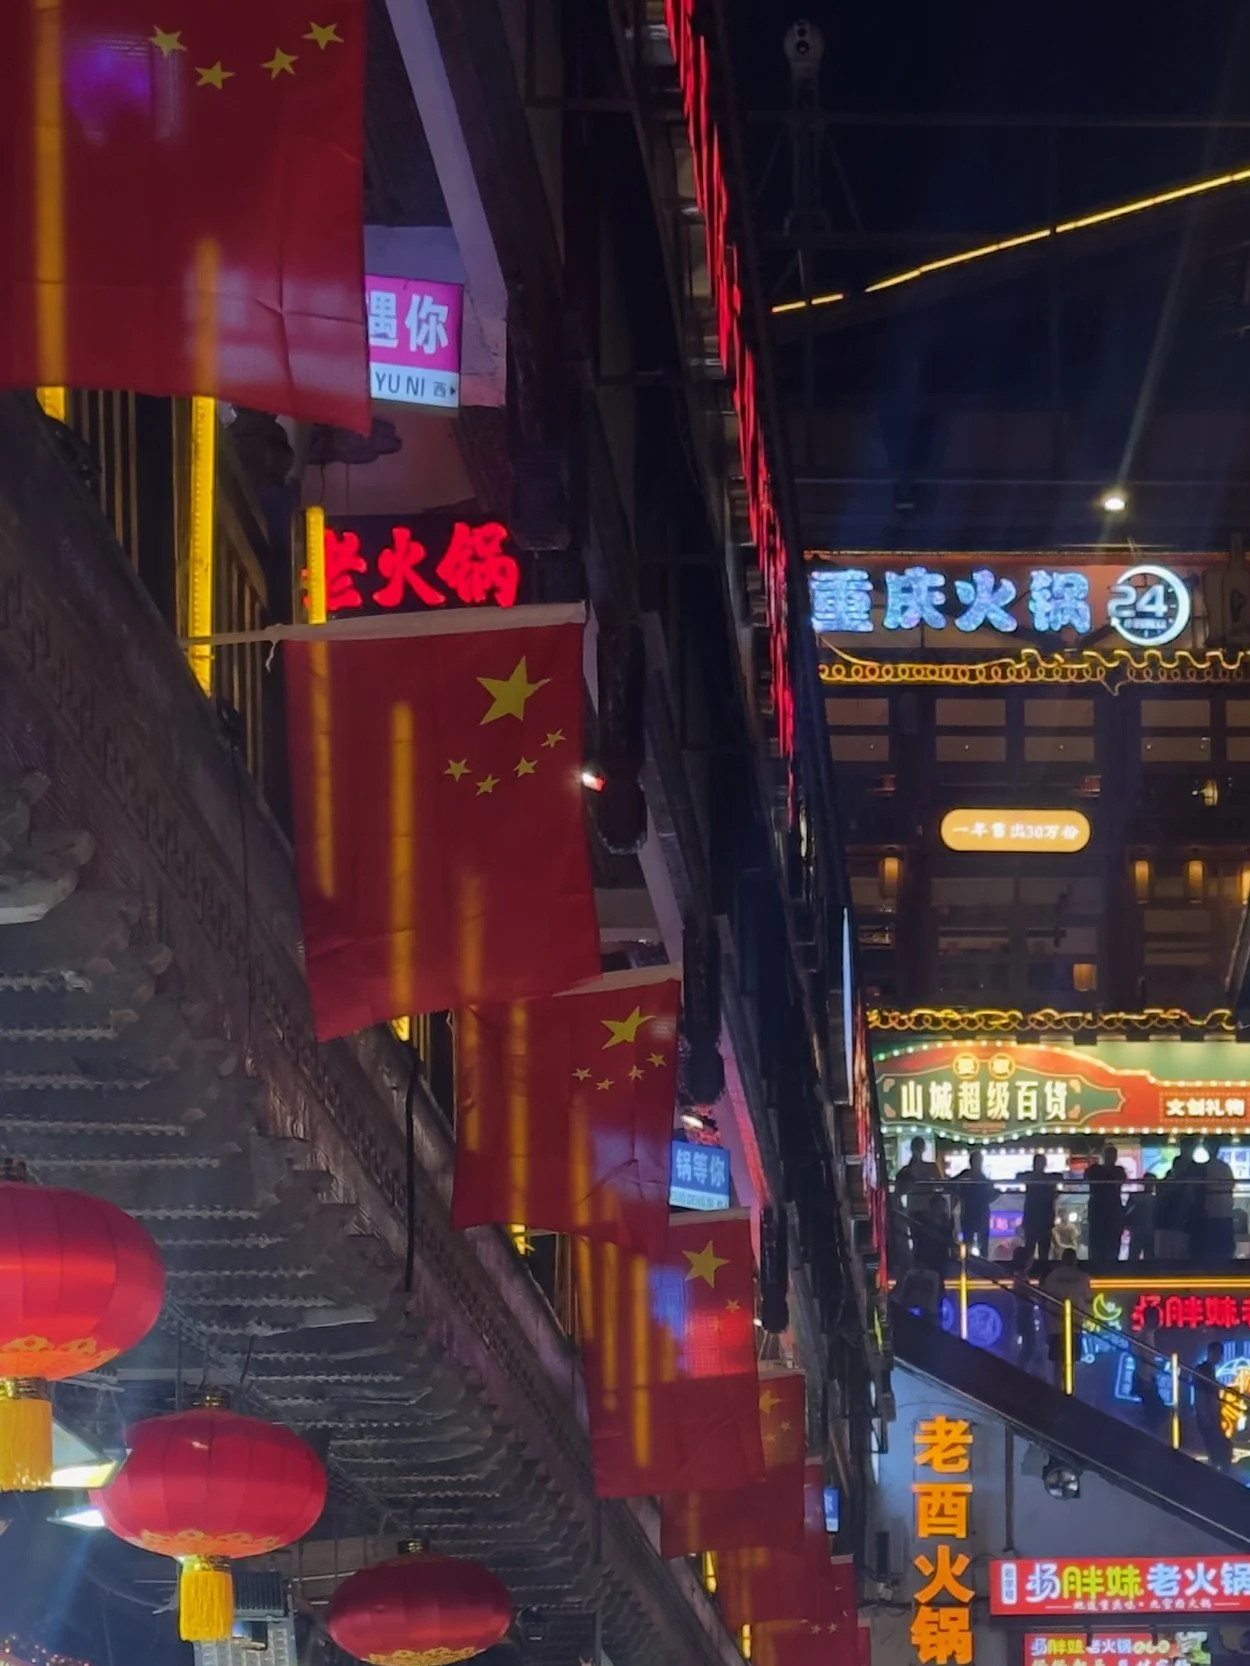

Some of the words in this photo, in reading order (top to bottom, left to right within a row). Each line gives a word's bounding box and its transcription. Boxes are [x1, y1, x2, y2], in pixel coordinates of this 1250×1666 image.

[375, 372, 401, 393] YU
[406, 376, 425, 397] NI
[302, 522, 520, 607] 老火锅
[810, 567, 1091, 634] 重庆火锅
[901, 1080, 1068, 1120] 山城超级百货
[1166, 1098, 1245, 1117] 文创礼物
